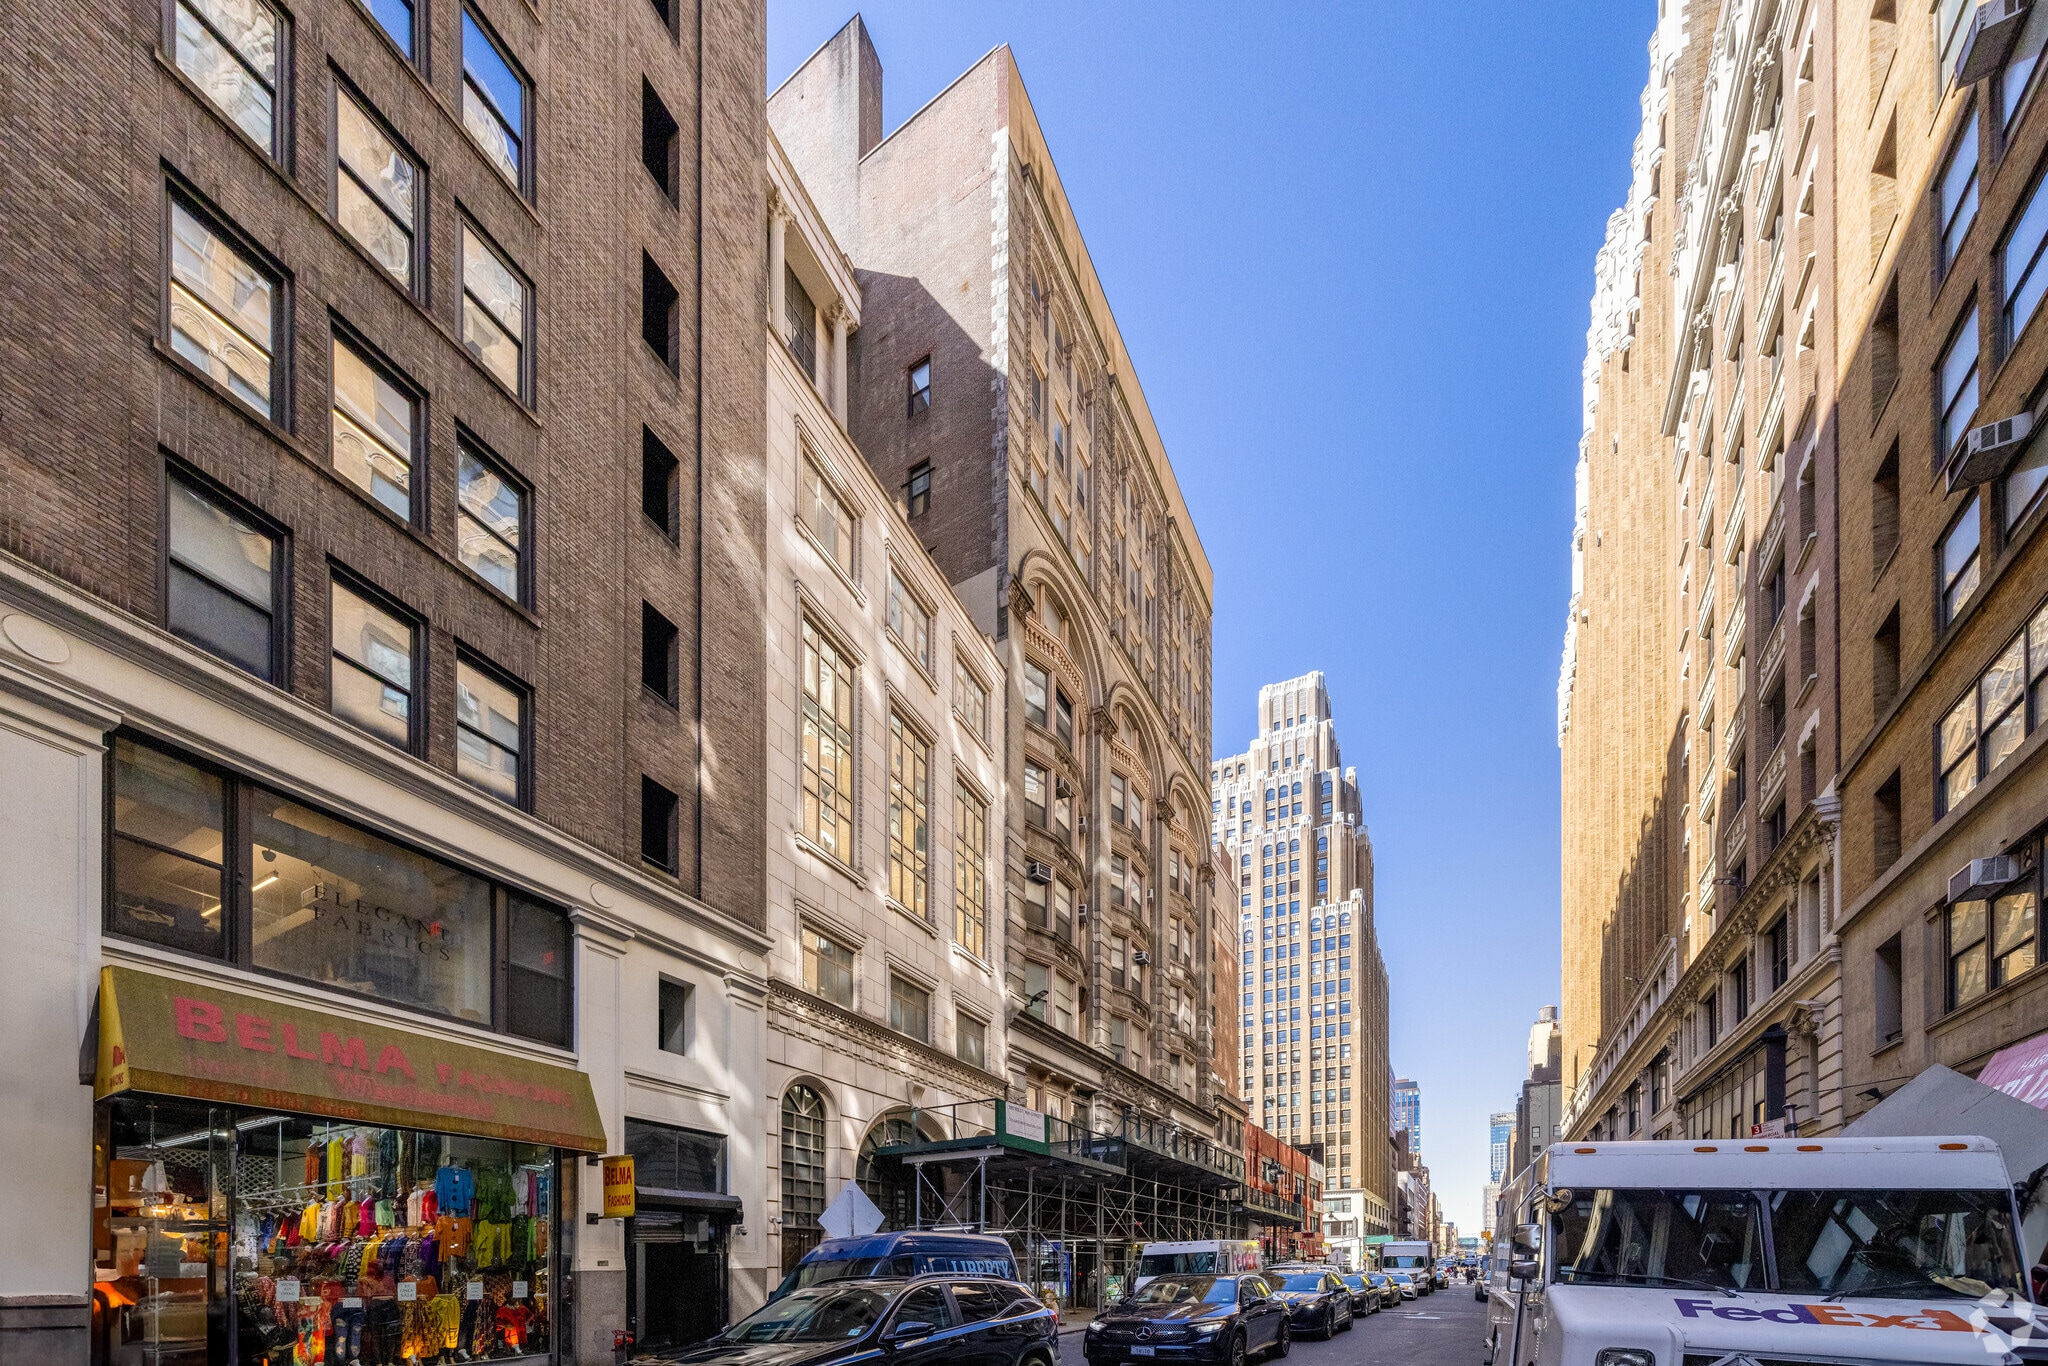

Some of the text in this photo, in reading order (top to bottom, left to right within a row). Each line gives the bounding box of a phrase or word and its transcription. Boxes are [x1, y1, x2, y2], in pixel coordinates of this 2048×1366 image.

[314, 884, 450, 941] ELEGANT
[314, 906, 450, 961] FABRICS
[173, 995, 417, 1081] BELMA
[436, 1063, 574, 1110] FASHIONS
[1753, 1125, 1761, 1134] 3
[604, 1165, 633, 1187] BELMA
[607, 1193, 632, 1208] FASHIONS
[950, 1260, 1010, 1279] LIBERTY
[1673, 1298, 1912, 1330] FedEx
